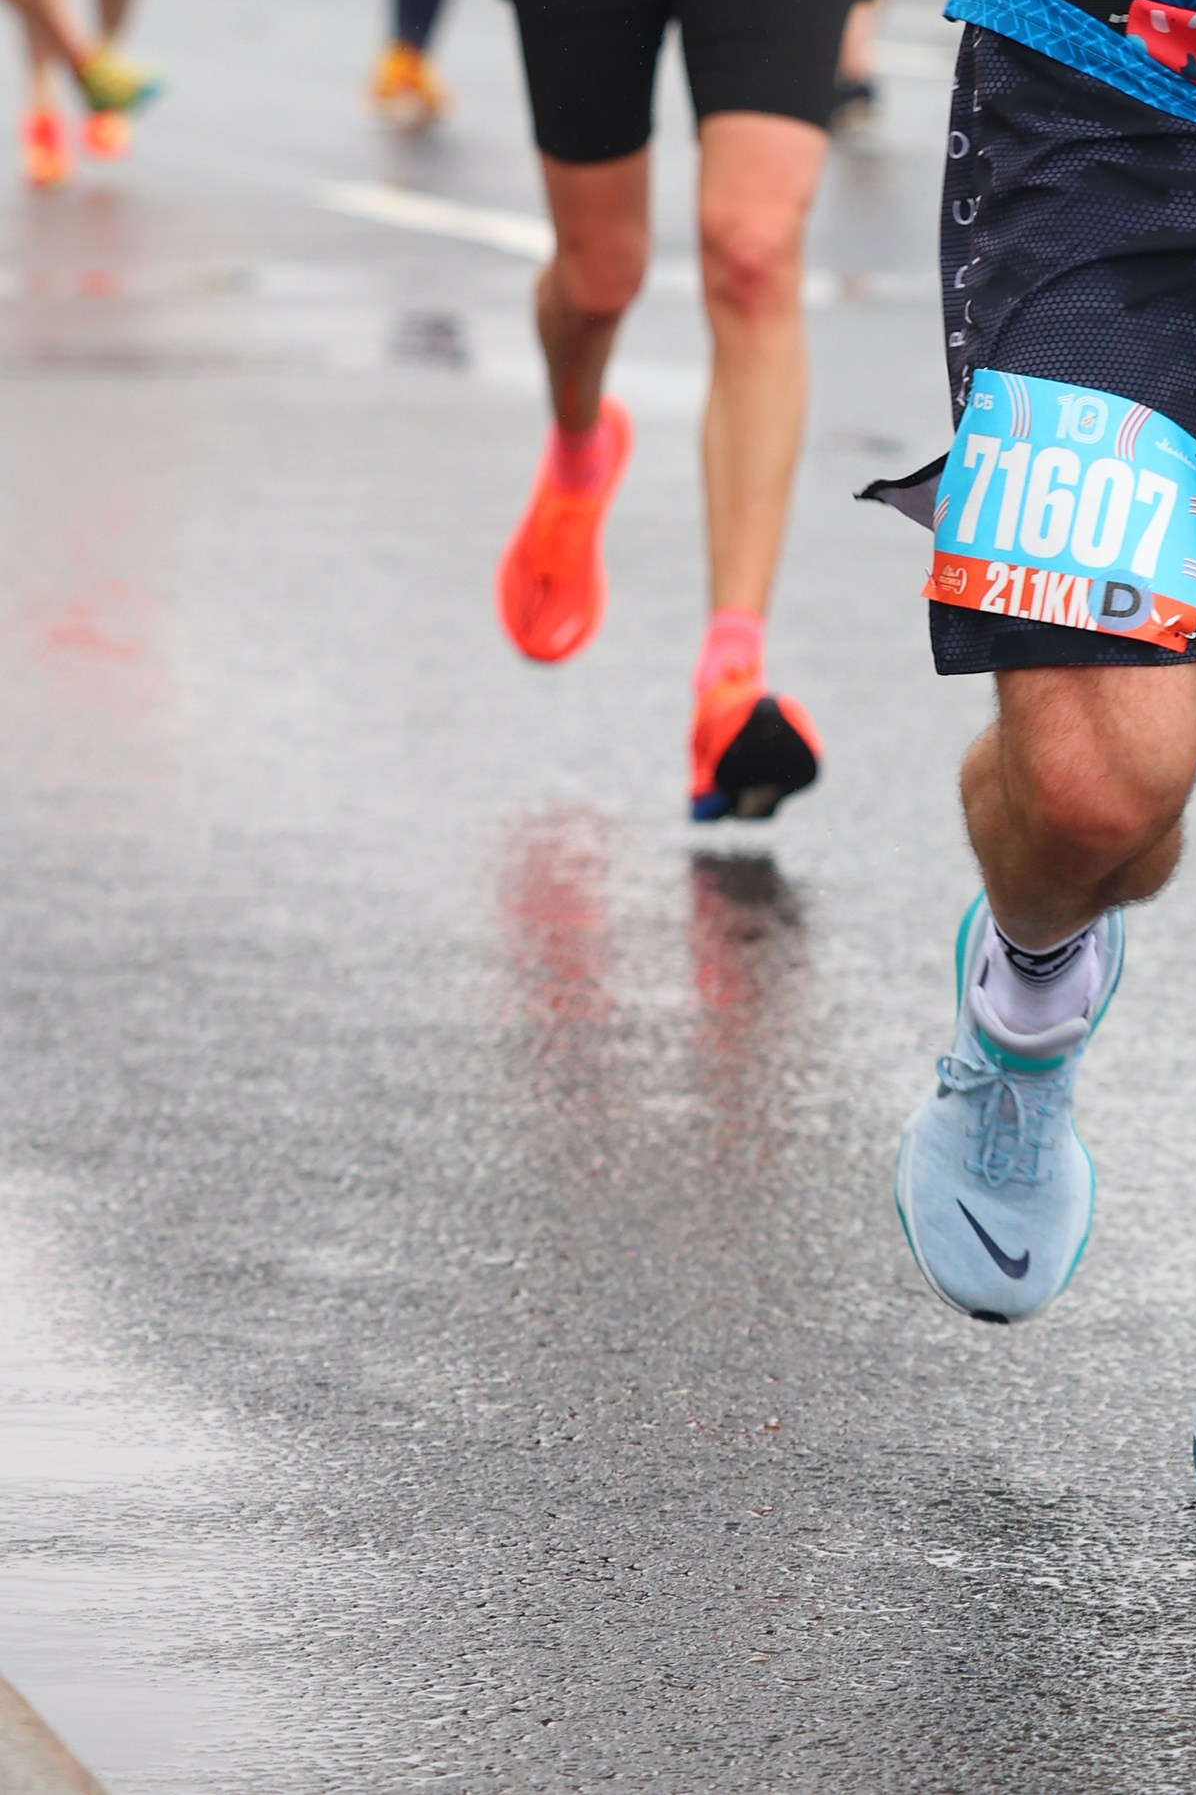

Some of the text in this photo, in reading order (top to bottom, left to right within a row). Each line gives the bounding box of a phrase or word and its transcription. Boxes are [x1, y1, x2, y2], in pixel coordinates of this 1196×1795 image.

[1056, 392, 1110, 444] 10
[955, 433, 1179, 579] 71607
[1101, 580, 1142, 618] D
